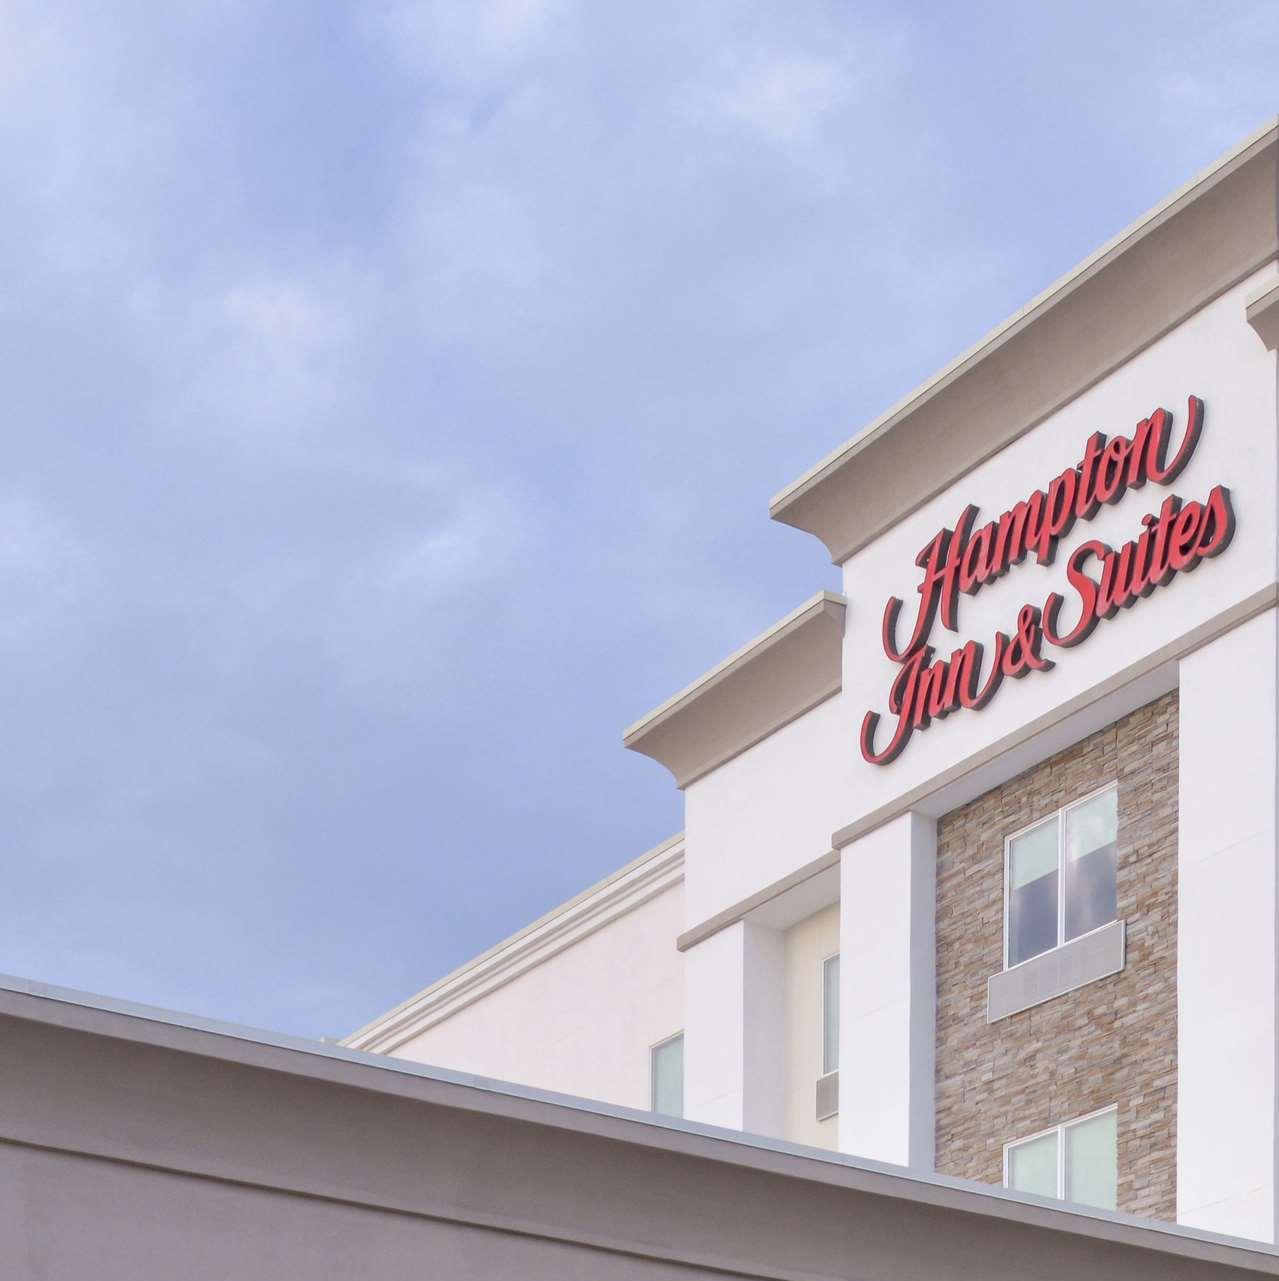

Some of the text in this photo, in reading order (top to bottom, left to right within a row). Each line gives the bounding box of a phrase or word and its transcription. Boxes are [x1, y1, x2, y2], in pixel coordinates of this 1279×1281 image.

[860, 485, 1236, 766] Inn & Suites
[882, 395, 1204, 664] Hampton
